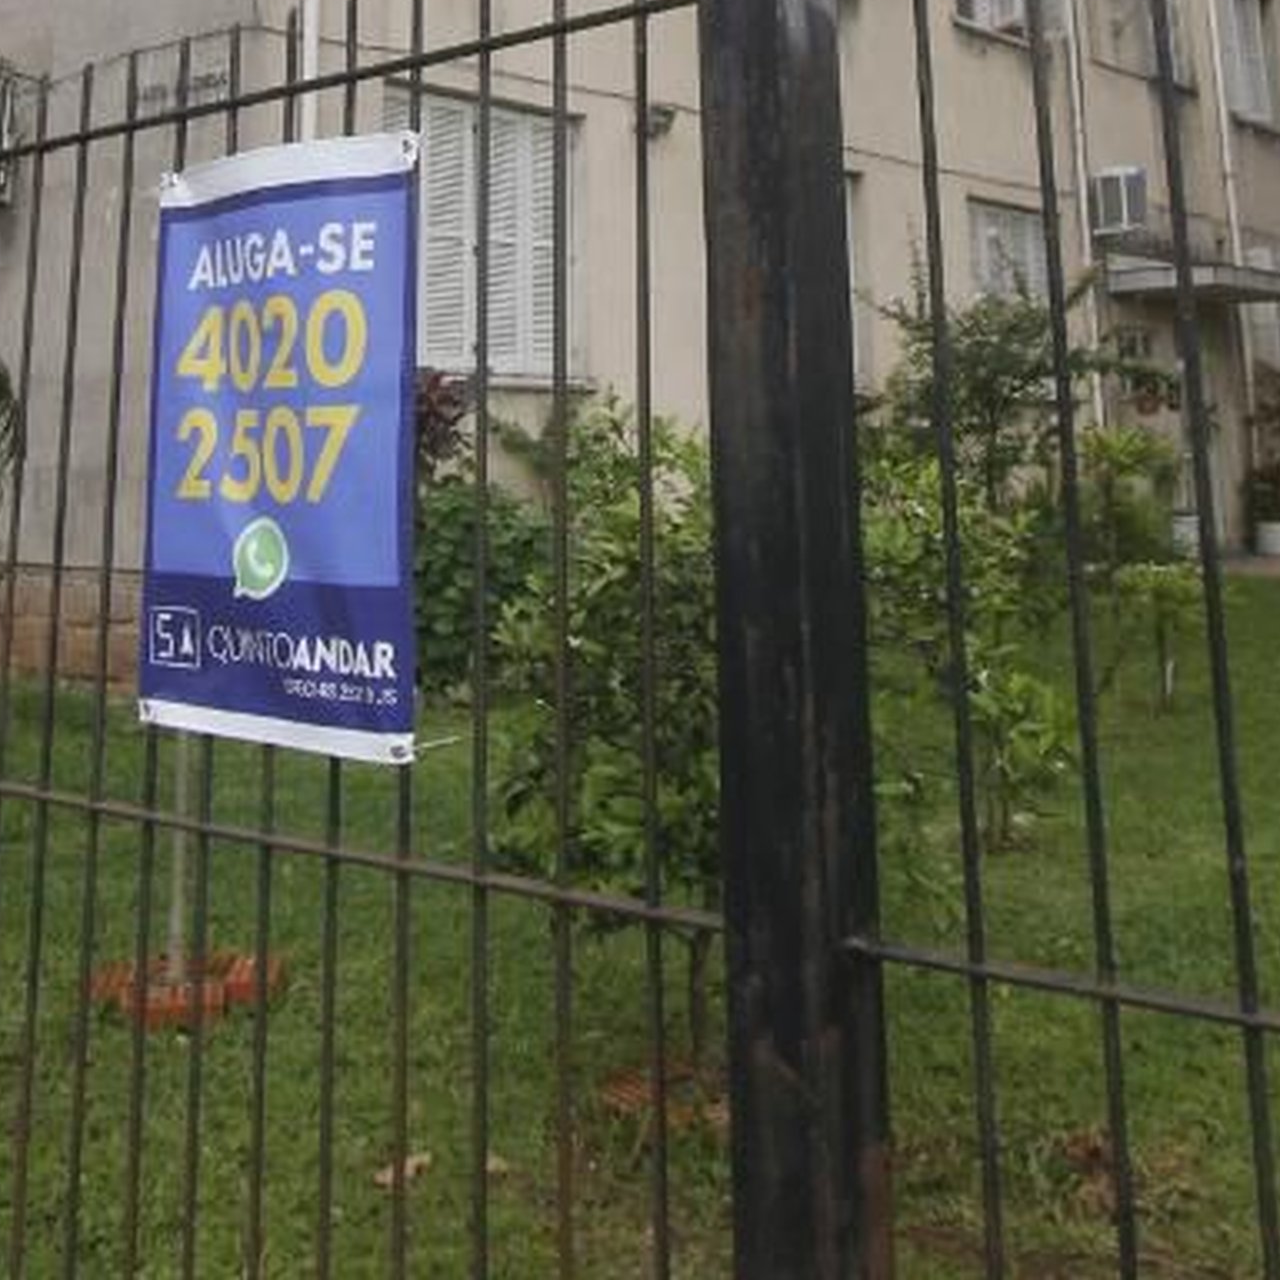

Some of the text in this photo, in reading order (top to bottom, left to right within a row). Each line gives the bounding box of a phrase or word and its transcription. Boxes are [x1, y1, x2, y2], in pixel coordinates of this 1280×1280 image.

[187, 221, 376, 290] ALUGA-SE
[176, 288, 367, 391] 4020
[176, 404, 361, 503] 2507
